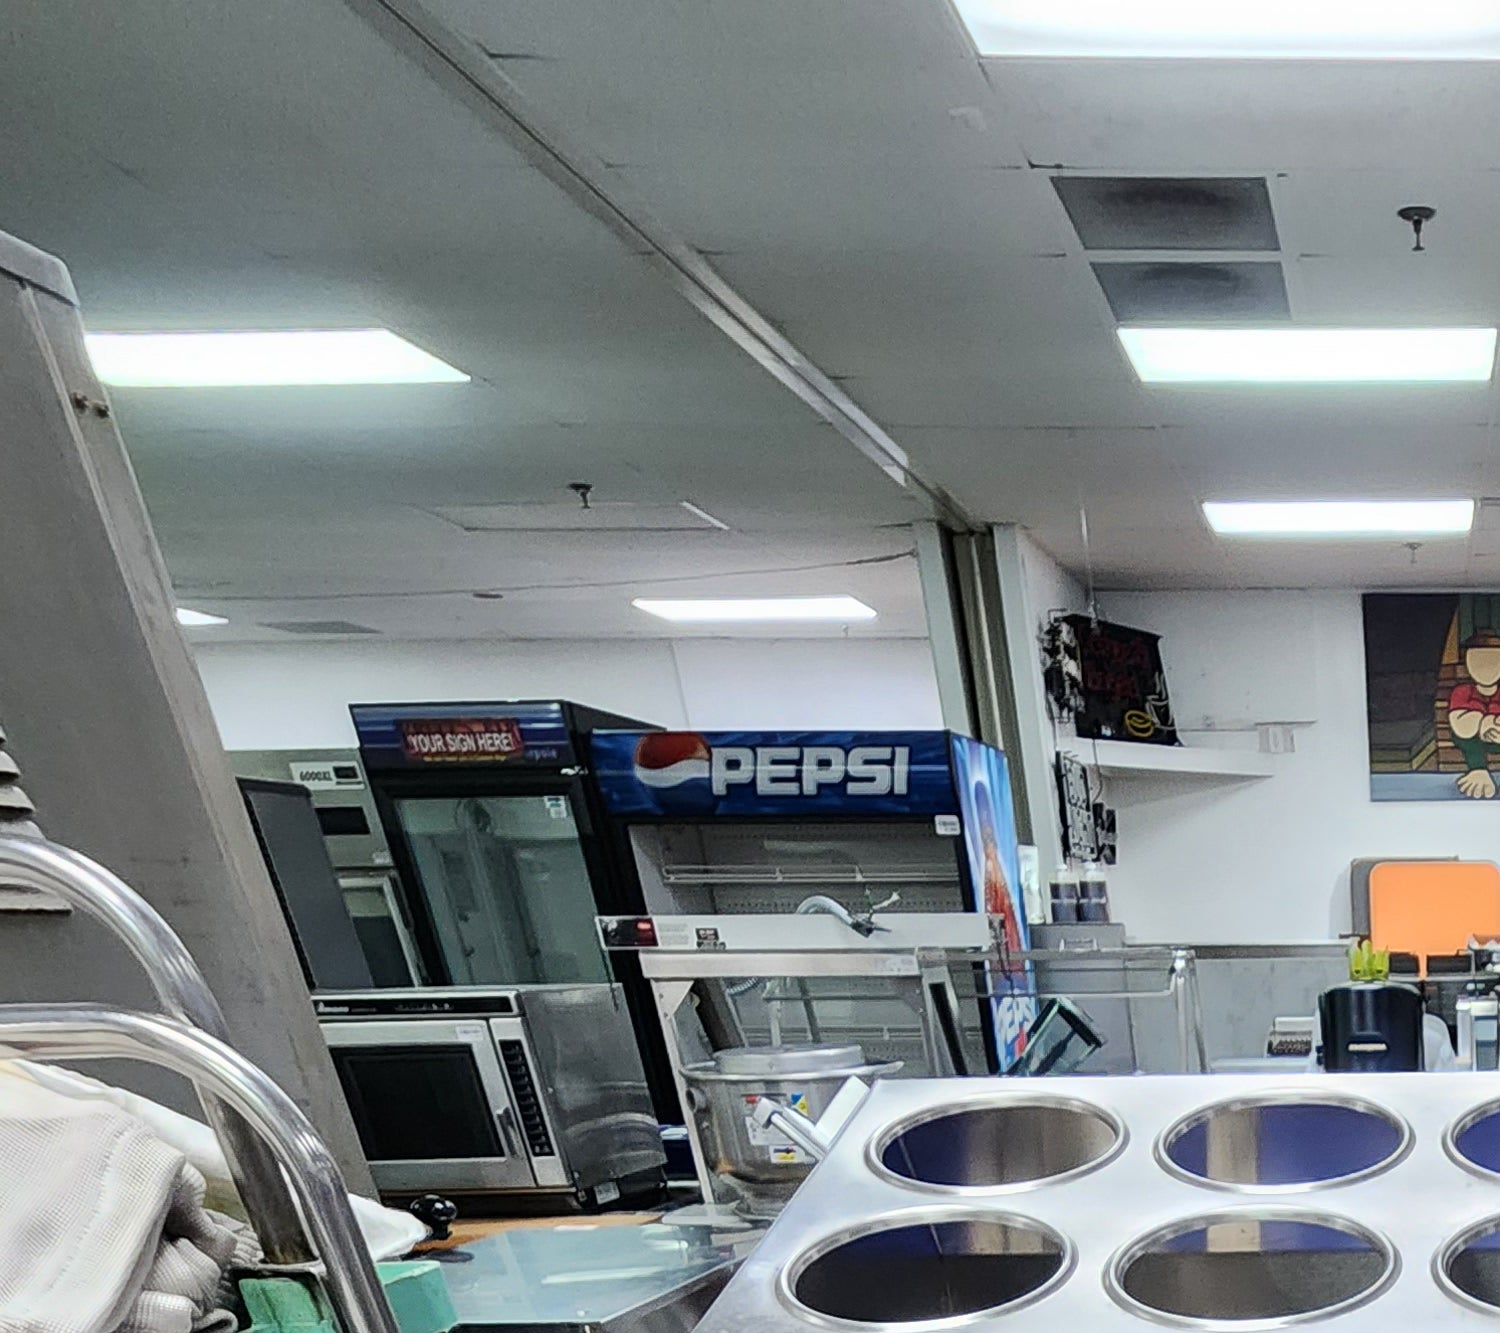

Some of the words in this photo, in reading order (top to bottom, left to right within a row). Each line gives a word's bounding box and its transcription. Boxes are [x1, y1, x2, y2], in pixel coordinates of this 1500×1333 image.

[408, 733, 446, 753] YOUR
[445, 732, 477, 753] SIGN
[477, 731, 515, 752] HERE!
[711, 746, 910, 796] PEPSI
